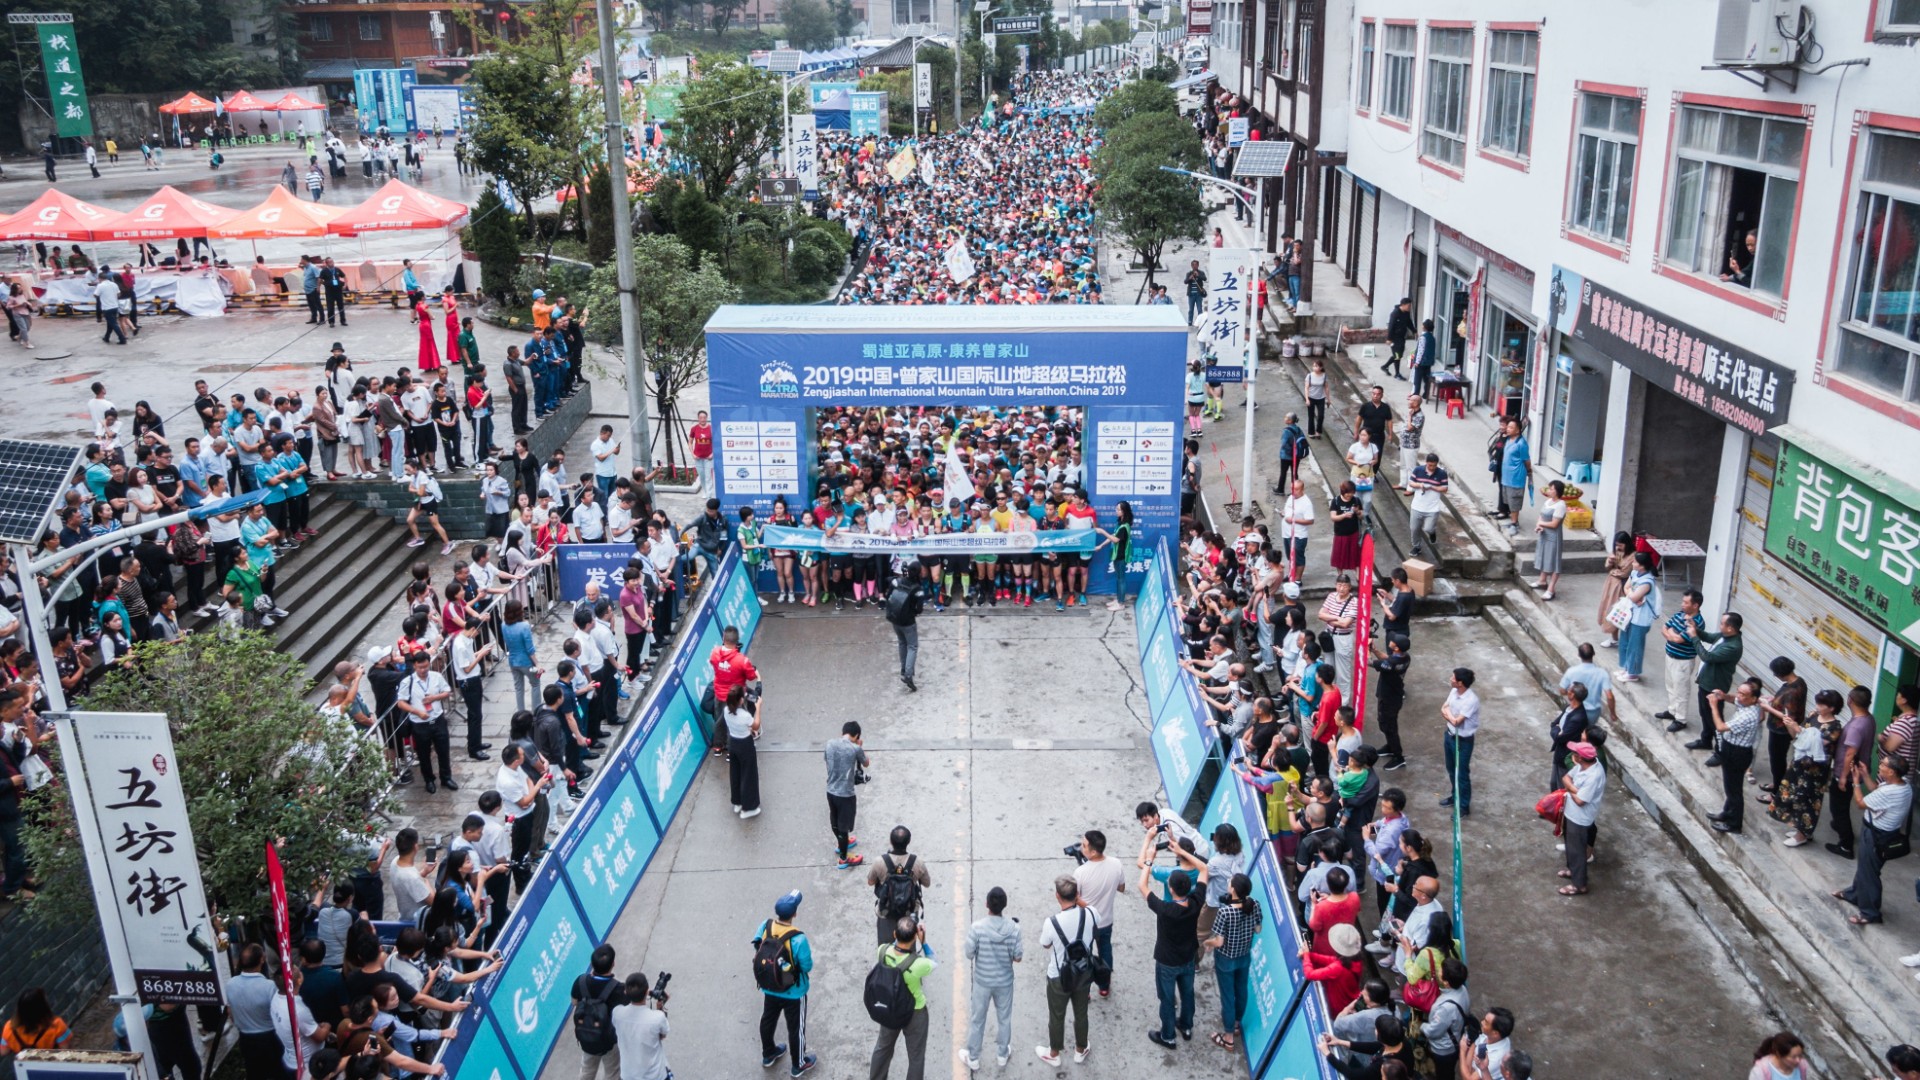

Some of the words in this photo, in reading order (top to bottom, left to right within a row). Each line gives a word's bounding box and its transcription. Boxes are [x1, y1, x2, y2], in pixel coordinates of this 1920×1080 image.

[47, 34, 83, 120] 栈道之都
[796, 129, 813, 177] 五坊街
[1211, 271, 1241, 347] 五坊街
[862, 343, 1029, 359] 蜀道亚高原·康养曾家山
[803, 365, 1126, 385] 2019中国·曾家山国际山地超级马拉松
[803, 386, 866, 399] Zengjiashan
[869, 386, 935, 397] International
[938, 386, 986, 397] Mountain
[989, 386, 1014, 397] Ultra
[1102, 386, 1126, 396] 2019
[1710, 395, 1765, 436] 18582066000
[1794, 461, 1920, 585] 背包客
[105, 767, 188, 930] 五坊街
[143, 979, 216, 994] 8687888
